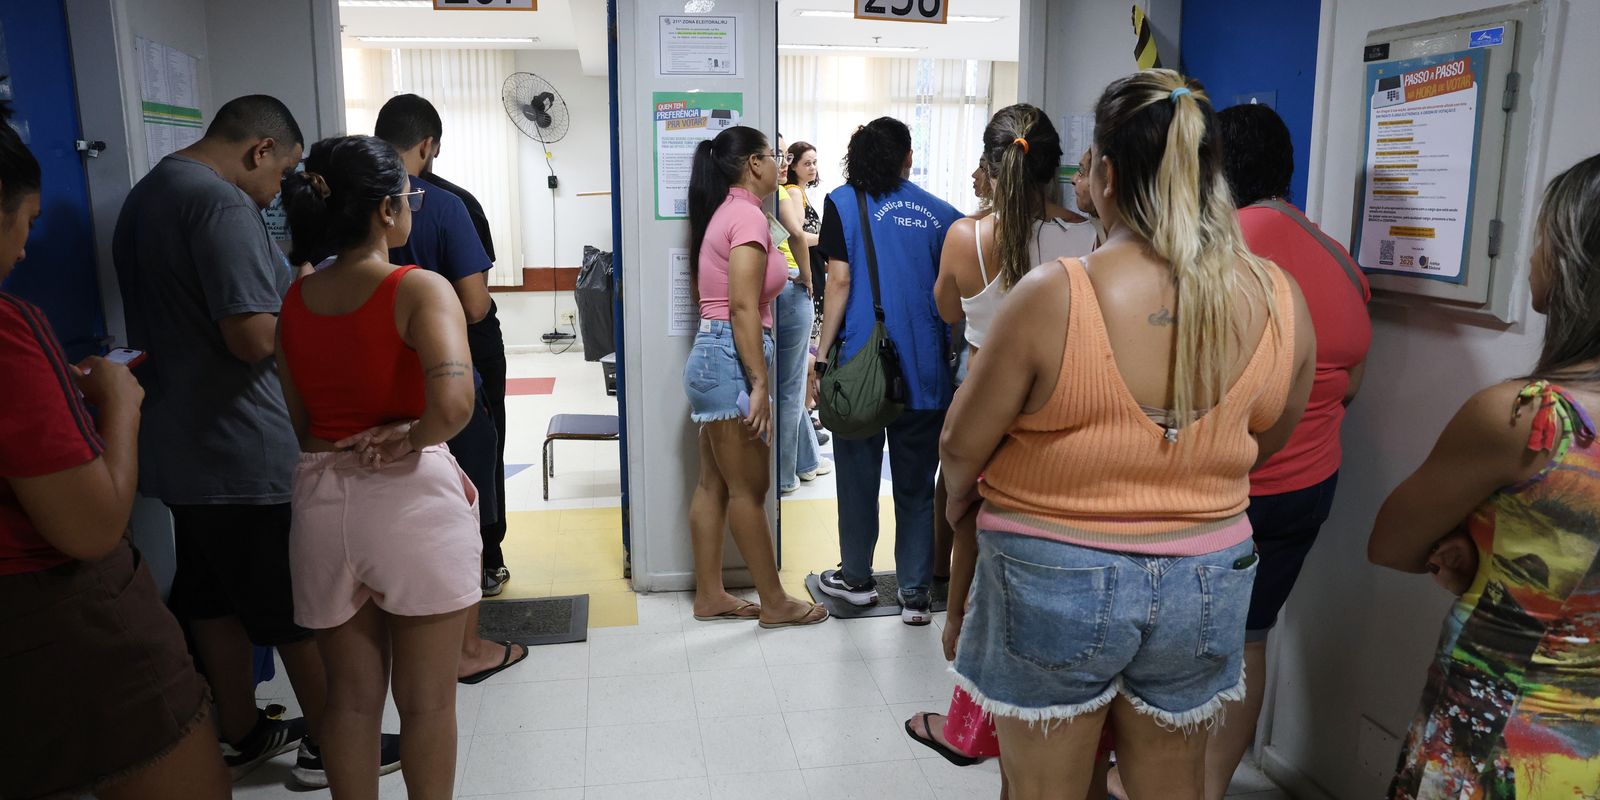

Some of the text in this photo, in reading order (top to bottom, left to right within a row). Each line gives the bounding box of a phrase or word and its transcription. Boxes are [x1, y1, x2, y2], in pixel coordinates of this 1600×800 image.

[1404, 70, 1430, 86] PASSO
[1435, 60, 1465, 79] PASSO
[1415, 86, 1437, 99] HORA
[1446, 74, 1471, 91] VOTAR
[658, 103, 672, 111] QUEM
[656, 108, 699, 120] PREFERÊNCIA
[667, 117, 707, 128] PRA VOTAR?
[873, 200, 942, 229] Justiça Eleitoral
[893, 215, 927, 228] TRE-RJ
